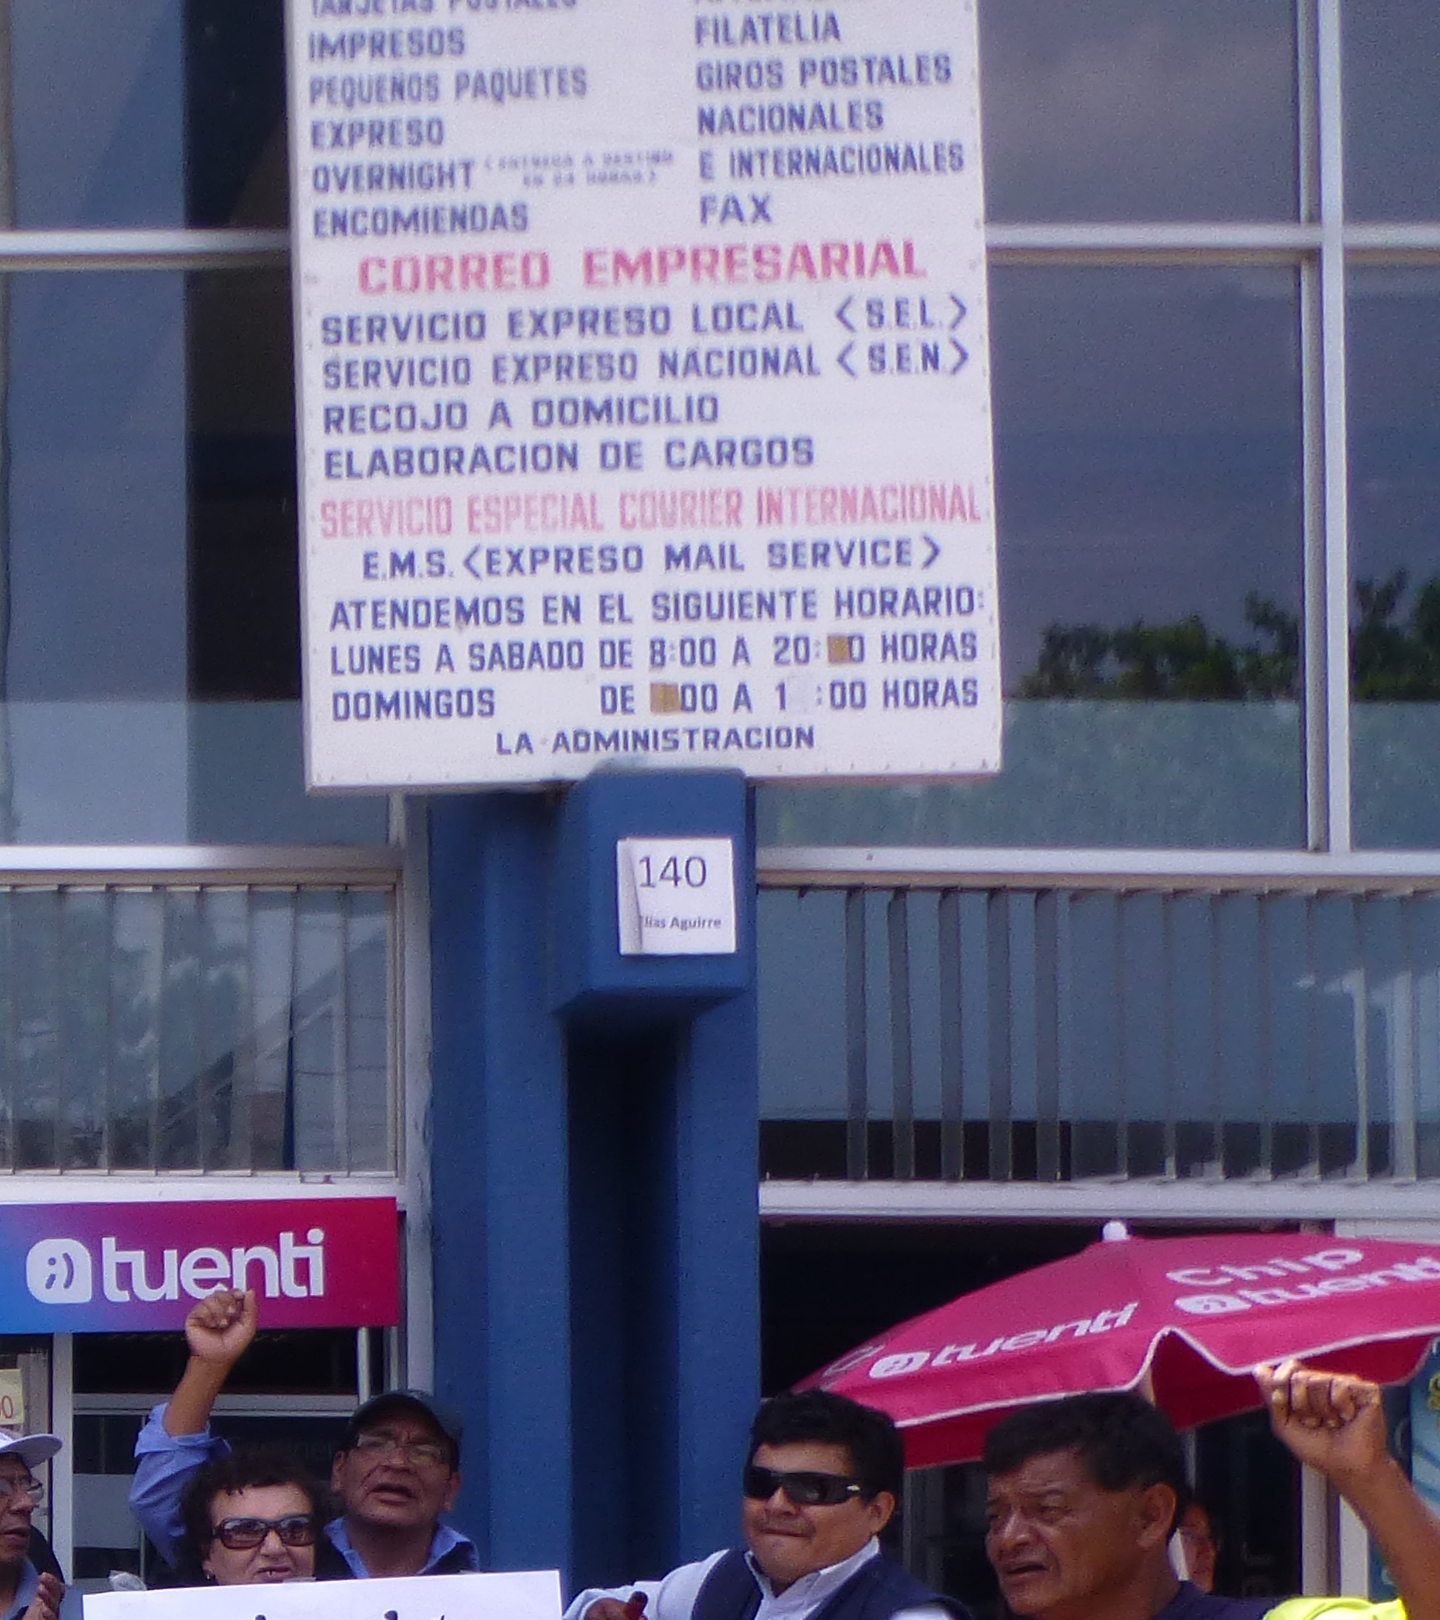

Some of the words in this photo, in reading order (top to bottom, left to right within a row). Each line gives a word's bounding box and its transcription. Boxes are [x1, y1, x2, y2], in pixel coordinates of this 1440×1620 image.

[308, 27, 465, 59] IMPRESOS
[695, 11, 841, 45] FILATELIA
[454, 65, 588, 105] PAQUETES
[696, 57, 784, 90] GIROS
[799, 52, 952, 87] POSTALES
[310, 116, 444, 148] EXPRESO
[698, 100, 884, 135] NACIONALES
[311, 158, 475, 192] OVERNIGHT
[699, 147, 715, 180] E
[729, 142, 964, 178] INTERNACIONALES
[312, 202, 529, 238] ENCOMIENDAS
[699, 192, 773, 225] FAX
[359, 251, 550, 295] CORREO
[583, 239, 928, 287] EMPRESARIAL
[321, 310, 486, 346] SERVICIO
[508, 302, 671, 340] EXPRESO
[692, 300, 805, 334] LOCAL
[322, 356, 471, 390] SERVICIO
[491, 349, 638, 385] EXPRESO
[659, 344, 822, 379] NACIONAL
[323, 400, 468, 435] RECOJO
[488, 400, 513, 430] A
[531, 391, 719, 428] DOMICILIO
[324, 440, 579, 480] ELABORACION
[599, 439, 643, 472] DE
[664, 436, 815, 468] CARGOS
[321, 496, 453, 540] SERVICIO
[466, 491, 604, 535] ESPECIAL
[619, 487, 743, 531] COURIER
[756, 482, 981, 525] INTERNACIONAL
[664, 541, 745, 572] MAIL
[329, 596, 525, 631] ATENDEMOS
[542, 594, 581, 626] EN
[598, 593, 634, 625] EL
[651, 588, 819, 622] SIGUIENTE
[331, 643, 421, 676] LUNES
[435, 643, 455, 674] A
[467, 639, 584, 672] SABADO
[598, 638, 634, 669] DE
[649, 636, 717, 668] 8:00
[732, 635, 752, 667] A
[773, 632, 866, 666] 20:0
[881, 631, 978, 664] HORAS
[332, 688, 496, 722] DOMINGOS
[600, 683, 636, 715] DE
[733, 681, 753, 714] A
[882, 677, 978, 711] HORAS
[496, 731, 535, 756] LA
[552, 724, 816, 755] ADMINISTRACION
[639, 855, 707, 888] 140
[640, 916, 666, 928] lias
[670, 916, 722, 931] Aguirre
[102, 1229, 324, 1301] tuenti
[1166, 1249, 1363, 1285] Chip
[933, 1302, 1139, 1366] tuenti
